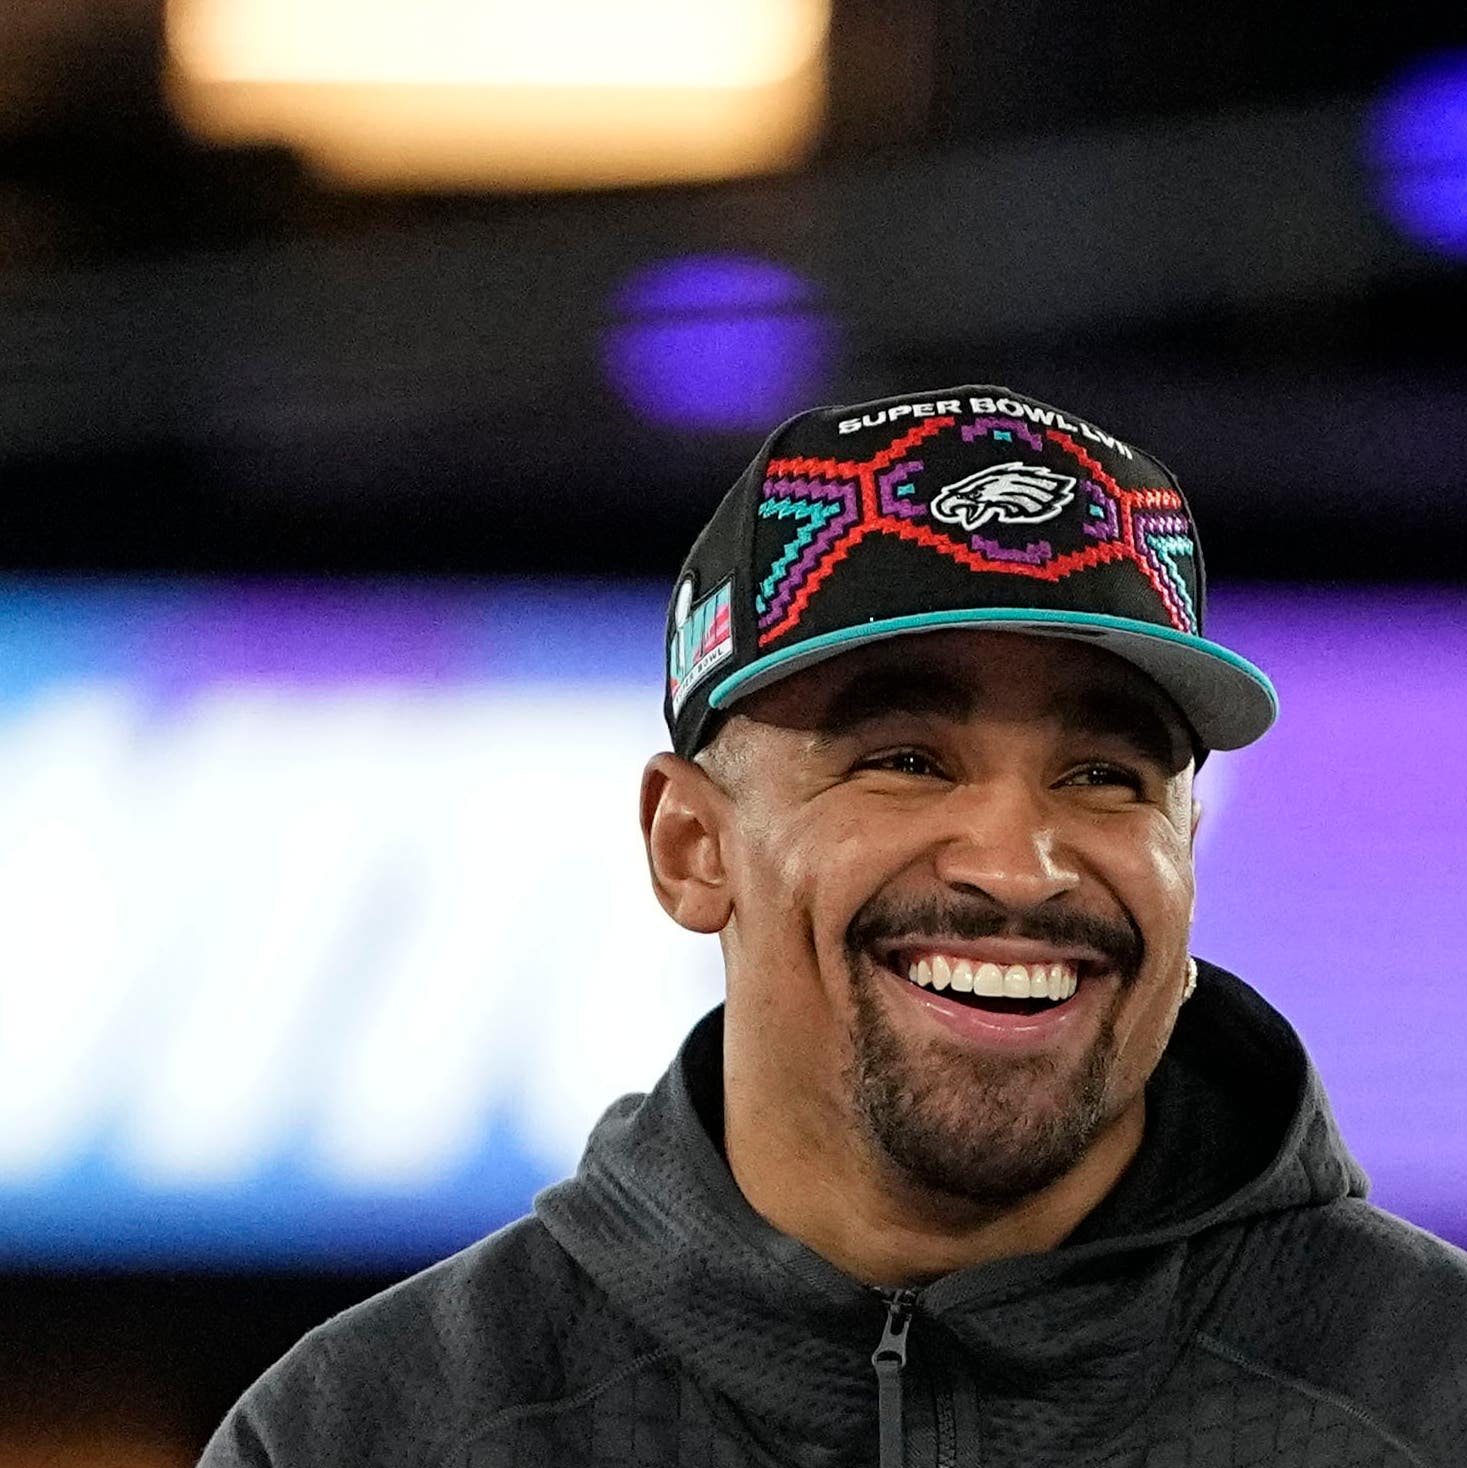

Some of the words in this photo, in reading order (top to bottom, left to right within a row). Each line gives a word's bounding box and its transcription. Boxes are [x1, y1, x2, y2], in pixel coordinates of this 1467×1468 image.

[838, 399, 962, 435] SUPER
[968, 397, 1078, 434] BOWL
[1080, 422, 1133, 460] LVII
